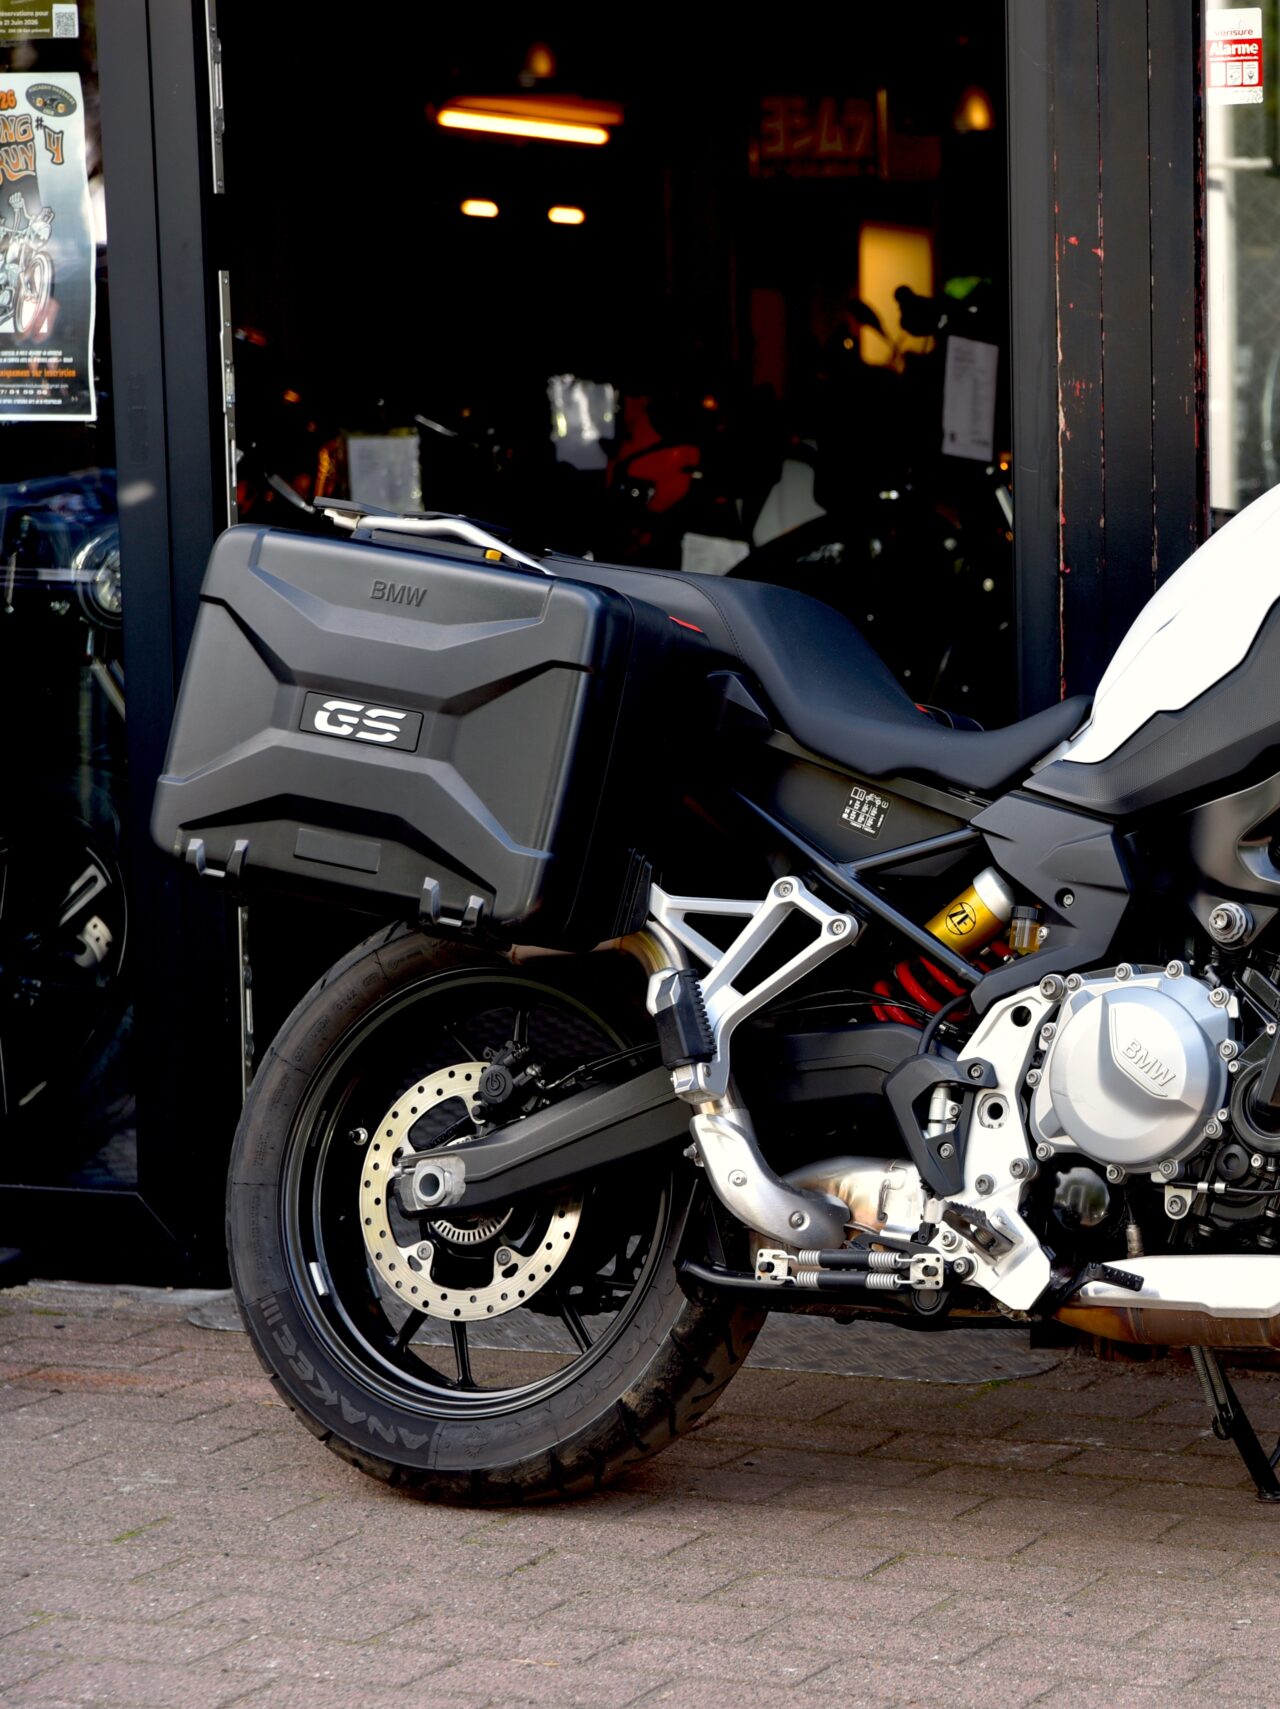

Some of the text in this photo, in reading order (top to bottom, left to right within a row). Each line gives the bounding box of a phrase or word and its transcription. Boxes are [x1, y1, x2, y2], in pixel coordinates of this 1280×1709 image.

[1208, 41, 1259, 56] Alarme
[1214, 28, 1254, 36] verisure
[369, 579, 429, 608] BMW
[313, 700, 407, 743] GS
[1121, 1037, 1177, 1087] BMW
[272, 1323, 430, 1450] ANAKEE
